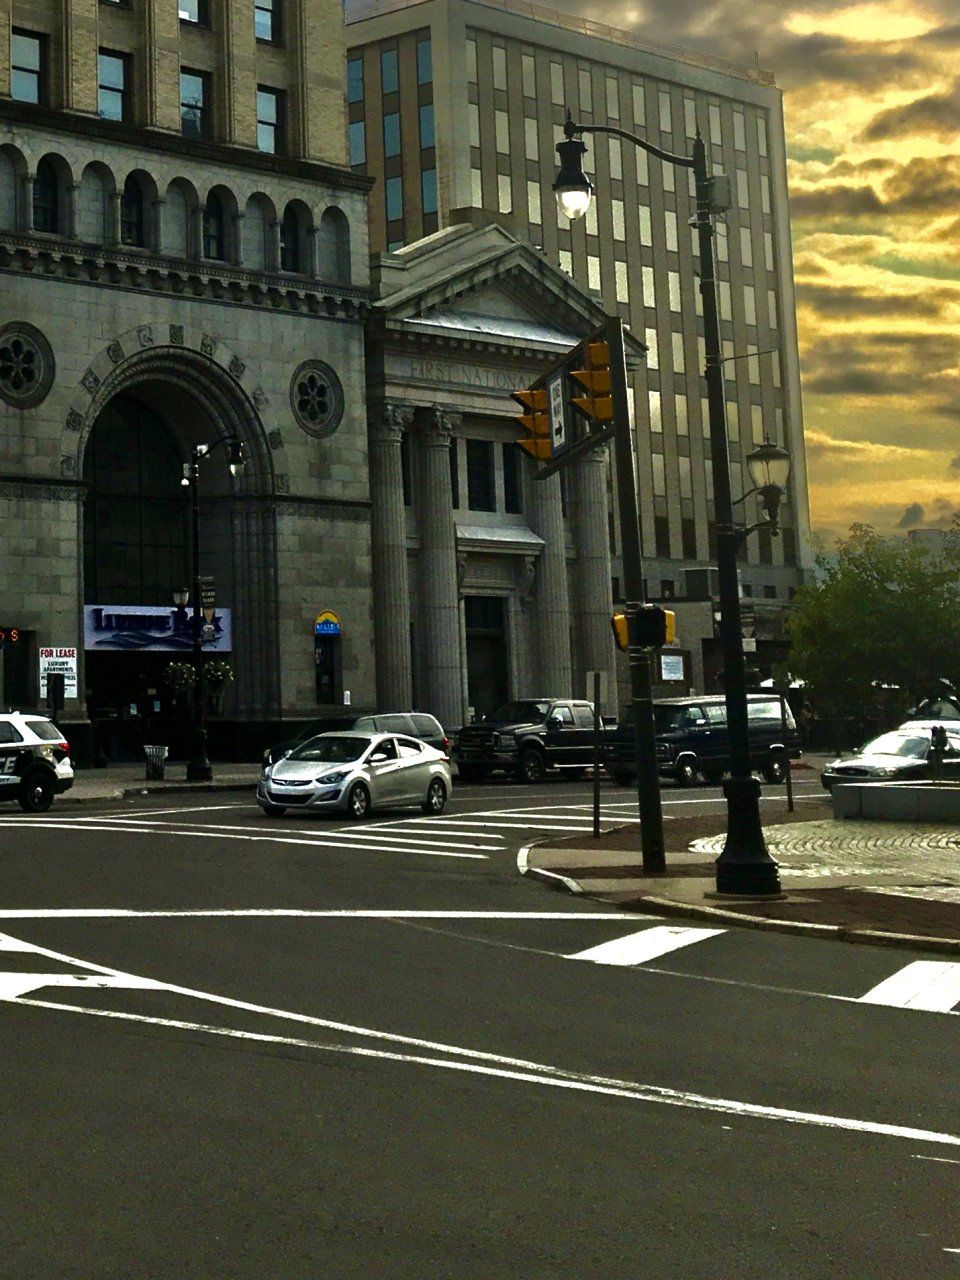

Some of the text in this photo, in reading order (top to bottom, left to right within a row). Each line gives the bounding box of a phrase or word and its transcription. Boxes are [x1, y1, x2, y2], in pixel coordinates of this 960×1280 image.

[411, 361, 452, 381] FIRST
[40, 648, 76, 658] FOR LEASE
